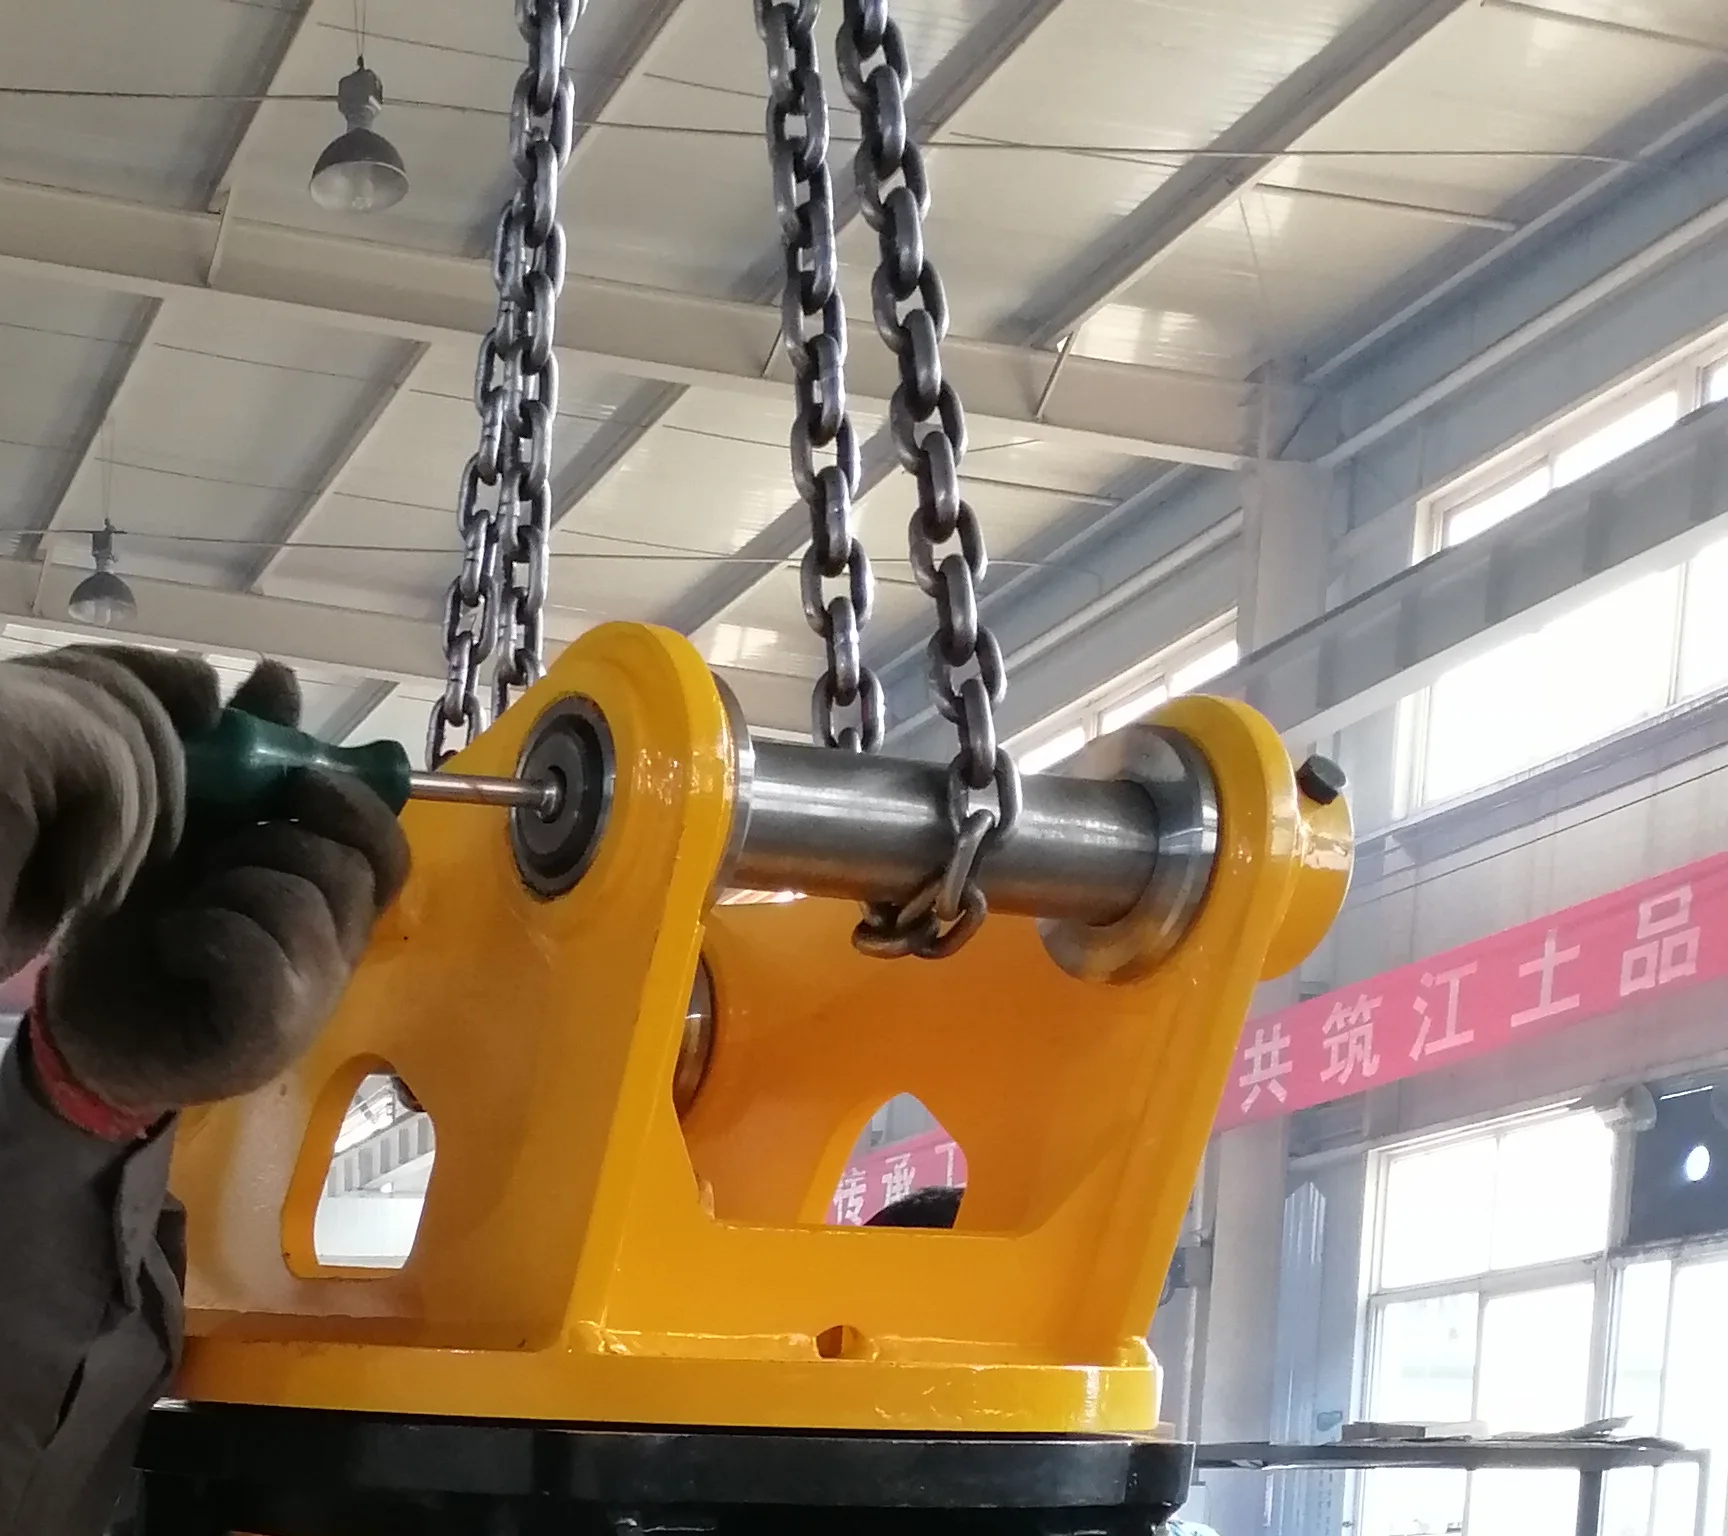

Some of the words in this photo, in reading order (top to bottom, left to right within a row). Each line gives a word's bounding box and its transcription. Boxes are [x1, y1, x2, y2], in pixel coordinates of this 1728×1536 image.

[1238, 883, 1701, 1114] 共筑江土品
